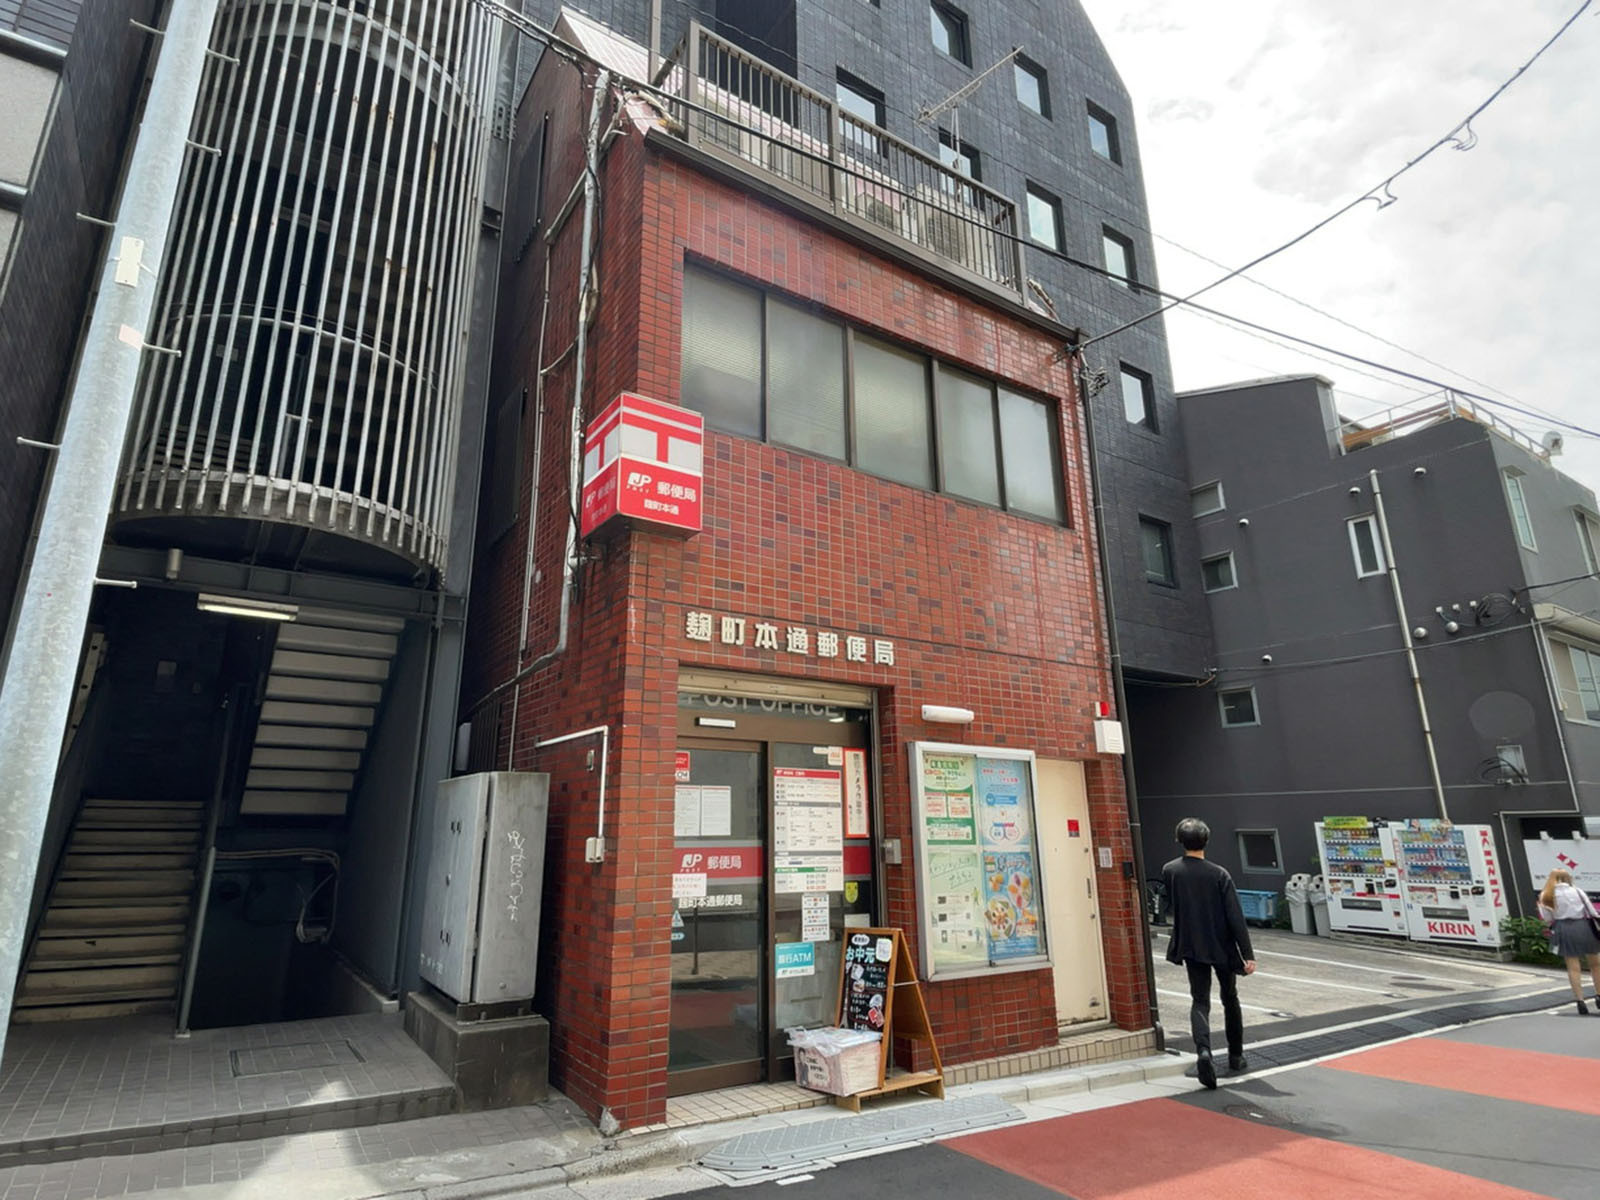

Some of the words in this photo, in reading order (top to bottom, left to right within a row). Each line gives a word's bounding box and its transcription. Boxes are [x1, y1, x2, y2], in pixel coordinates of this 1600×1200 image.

[656, 481, 697, 503] 郵便局
[706, 855, 742, 870] 郵便局
[1427, 921, 1476, 936] KIRIN
[845, 945, 876, 963] お中元
